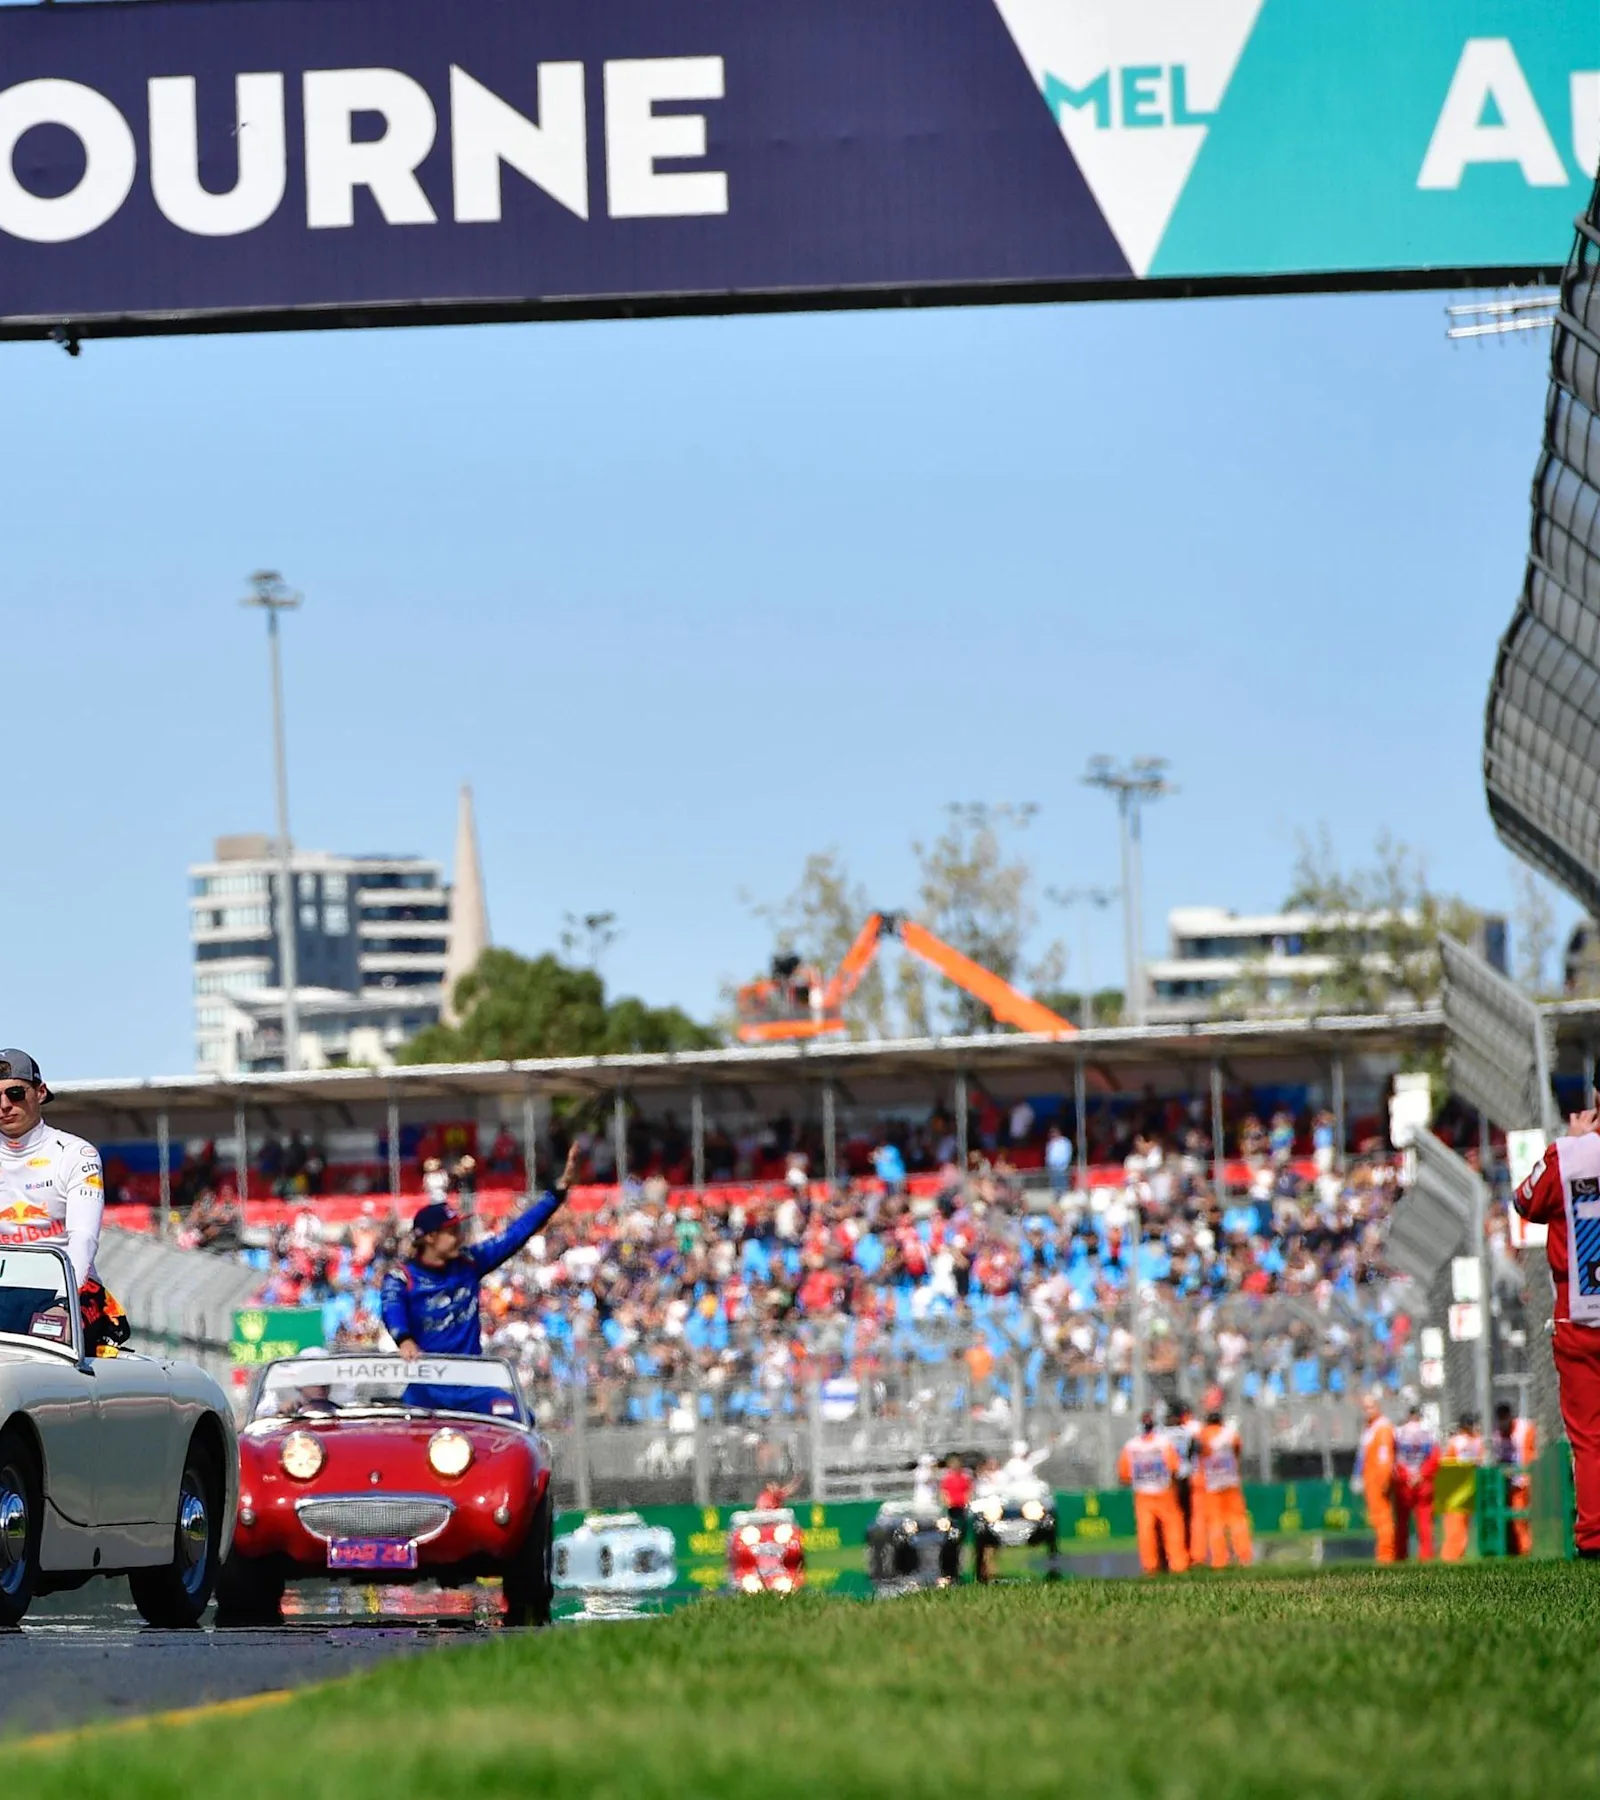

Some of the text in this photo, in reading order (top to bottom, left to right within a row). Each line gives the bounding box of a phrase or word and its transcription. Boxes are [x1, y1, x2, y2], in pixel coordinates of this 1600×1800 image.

[1043, 64, 1217, 131] MEL
[26, 1218, 64, 1243] Bull
[336, 1362, 448, 1379] HARTLEY
